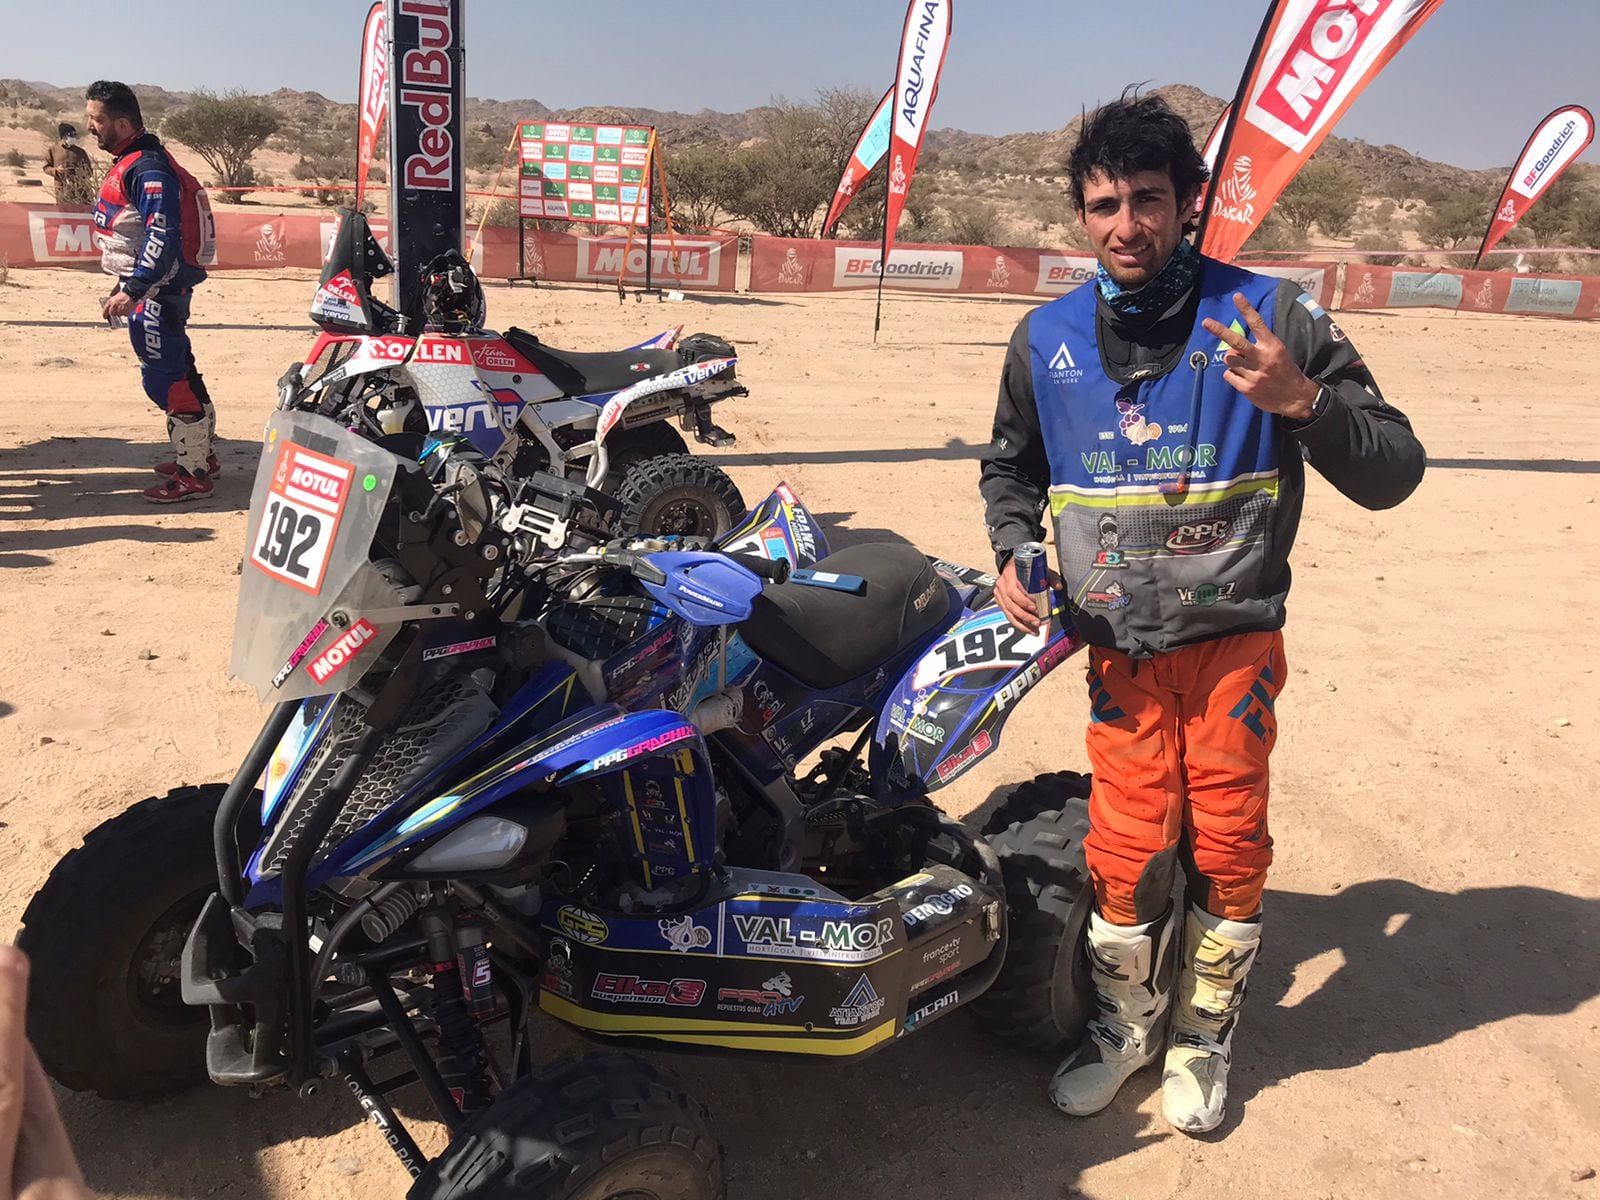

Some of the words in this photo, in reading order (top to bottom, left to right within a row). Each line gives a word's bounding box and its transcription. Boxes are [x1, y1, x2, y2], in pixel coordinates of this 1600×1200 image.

[401, 89, 453, 192] Red
[1523, 119, 1576, 189] BFGoodrich
[1213, 196, 1255, 225] DAKAR
[594, 247, 706, 276] MOTUL
[1081, 451, 1122, 474] VAL
[1146, 442, 1219, 471] MOR
[290, 466, 340, 499] MOTUL
[258, 500, 322, 580] 192
[1175, 519, 1228, 544] PPG
[313, 623, 375, 682] MOTUL
[934, 622, 1032, 677] 192
[732, 914, 797, 945] VAL
[823, 917, 895, 950] MOR
[598, 972, 670, 996] Elka
[369, 1109, 400, 1147] STAR
